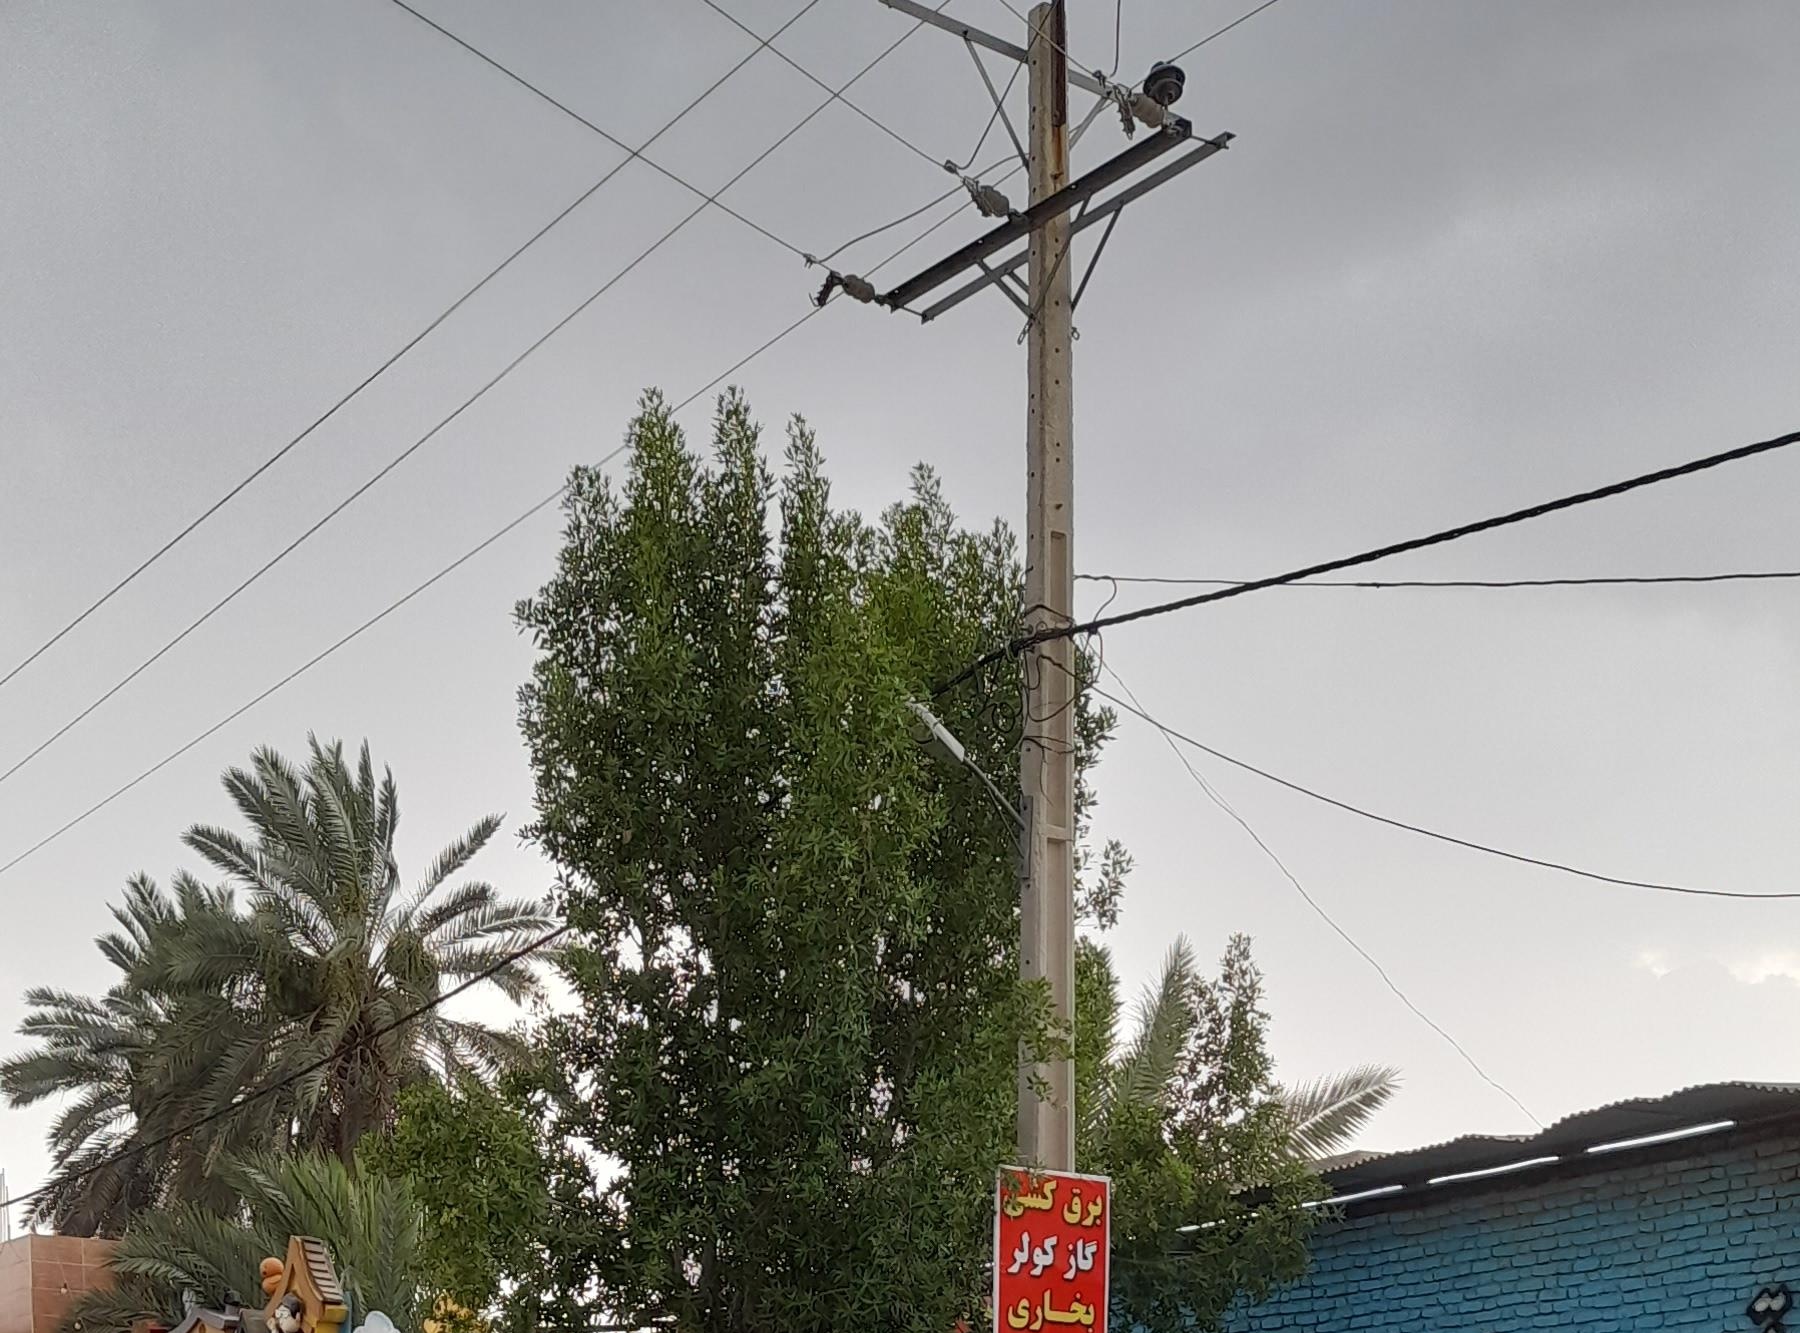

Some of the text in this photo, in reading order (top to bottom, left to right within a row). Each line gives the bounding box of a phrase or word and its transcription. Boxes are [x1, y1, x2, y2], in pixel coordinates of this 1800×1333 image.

[1063, 1188, 1103, 1226] برق
[1007, 1231, 1098, 1280] گاز کولر
[1007, 1288, 1095, 1333] بخاری
